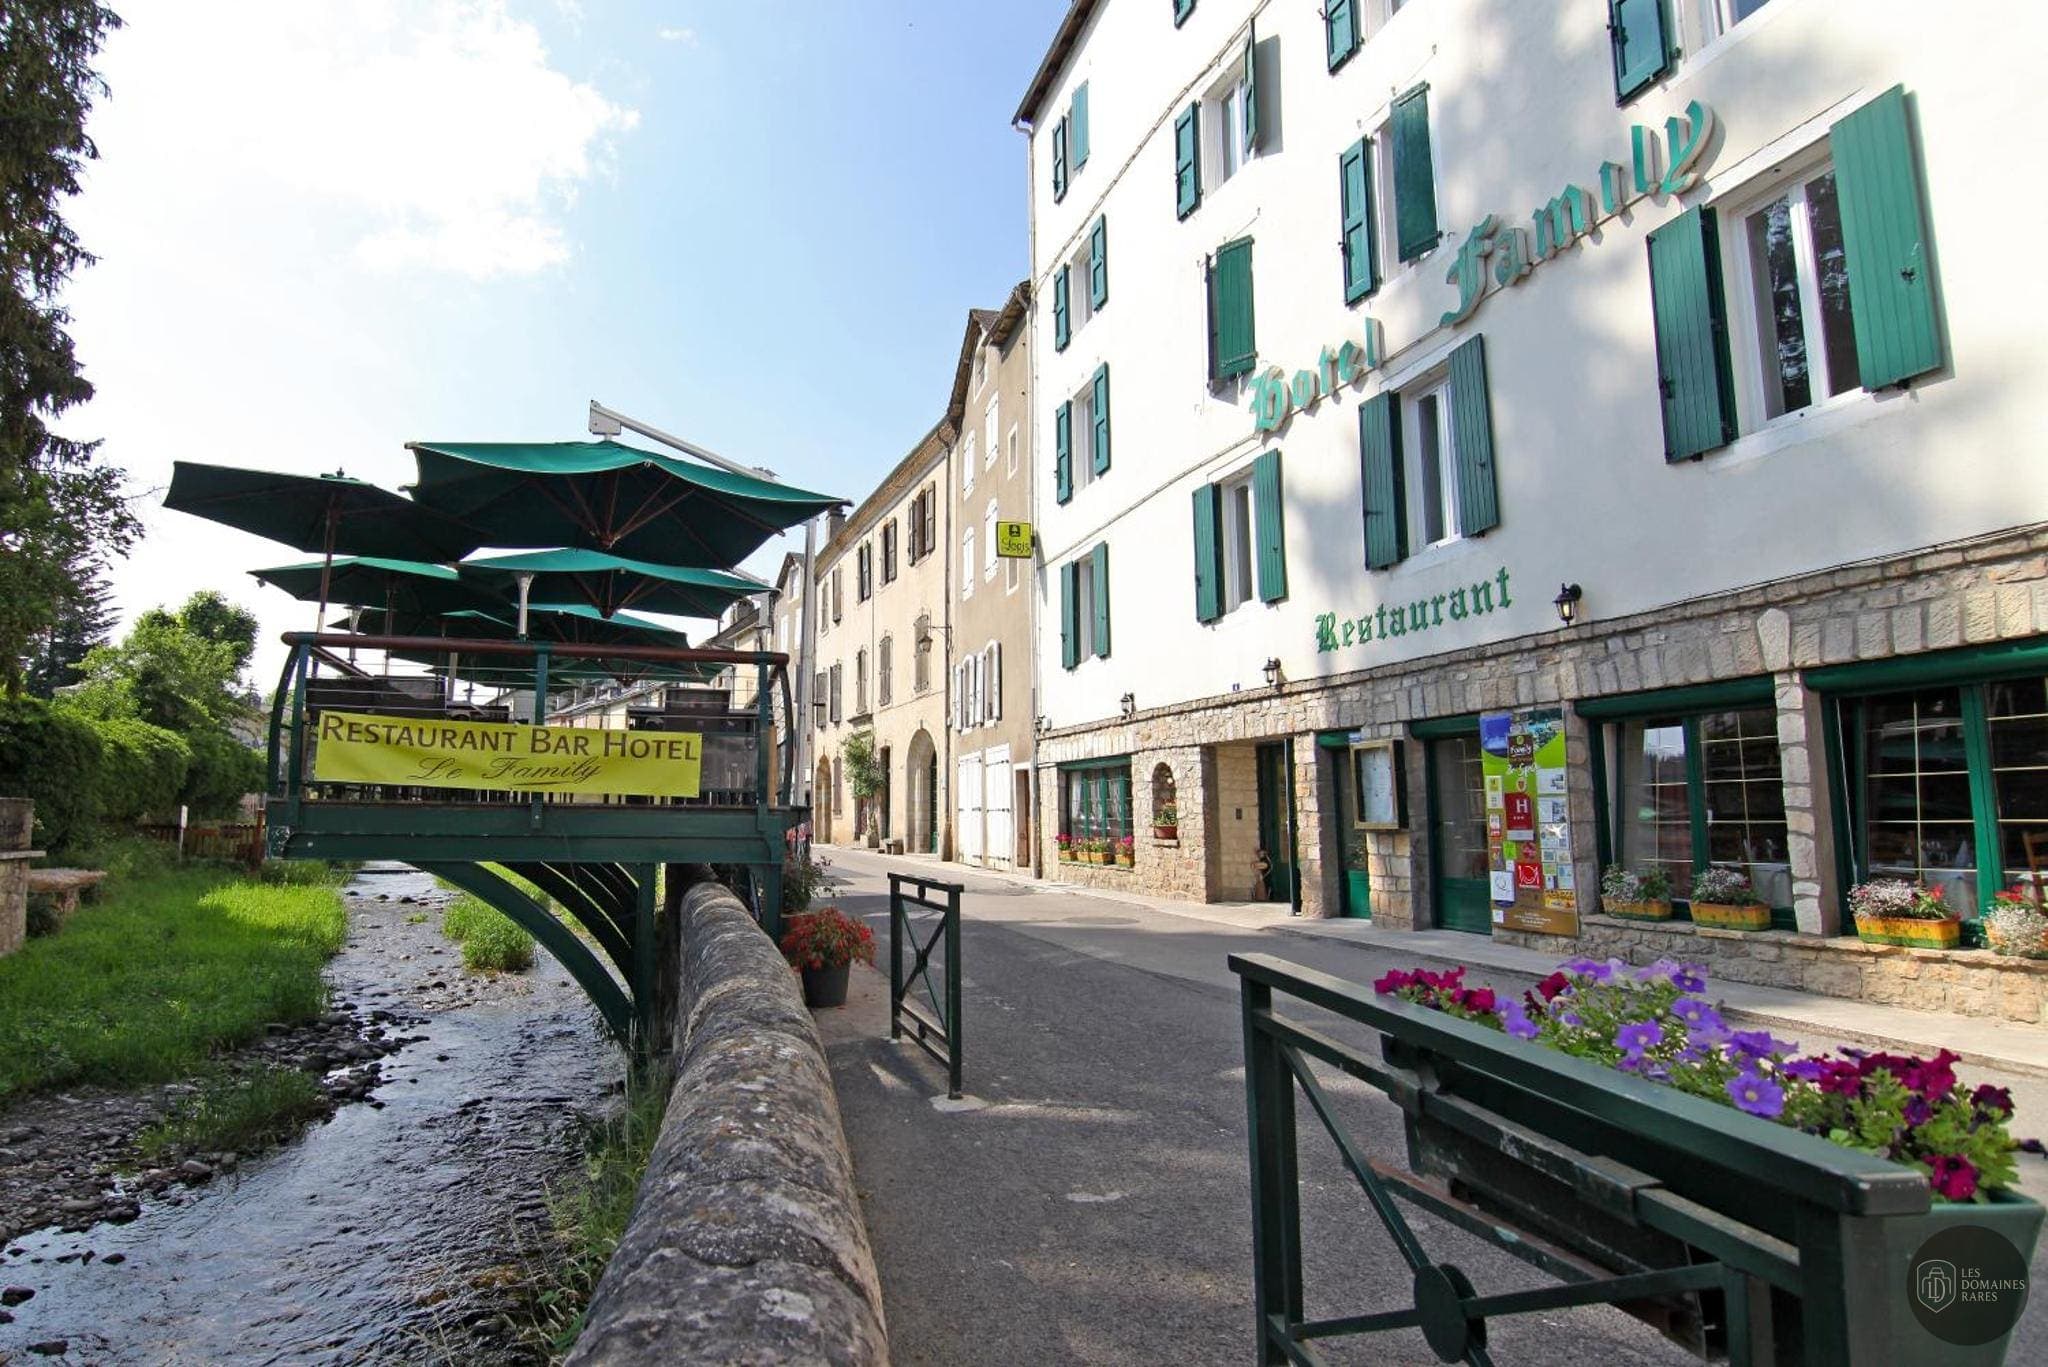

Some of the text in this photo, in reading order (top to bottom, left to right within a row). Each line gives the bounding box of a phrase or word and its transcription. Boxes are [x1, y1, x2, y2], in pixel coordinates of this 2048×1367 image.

[1249, 99, 1717, 433] Hotel Family
[1315, 566, 1513, 654] Restaurant
[321, 714, 699, 761] RESTAURANT BAR HOTEL
[407, 755, 602, 786] Le Family
[1515, 798, 1529, 814] H
